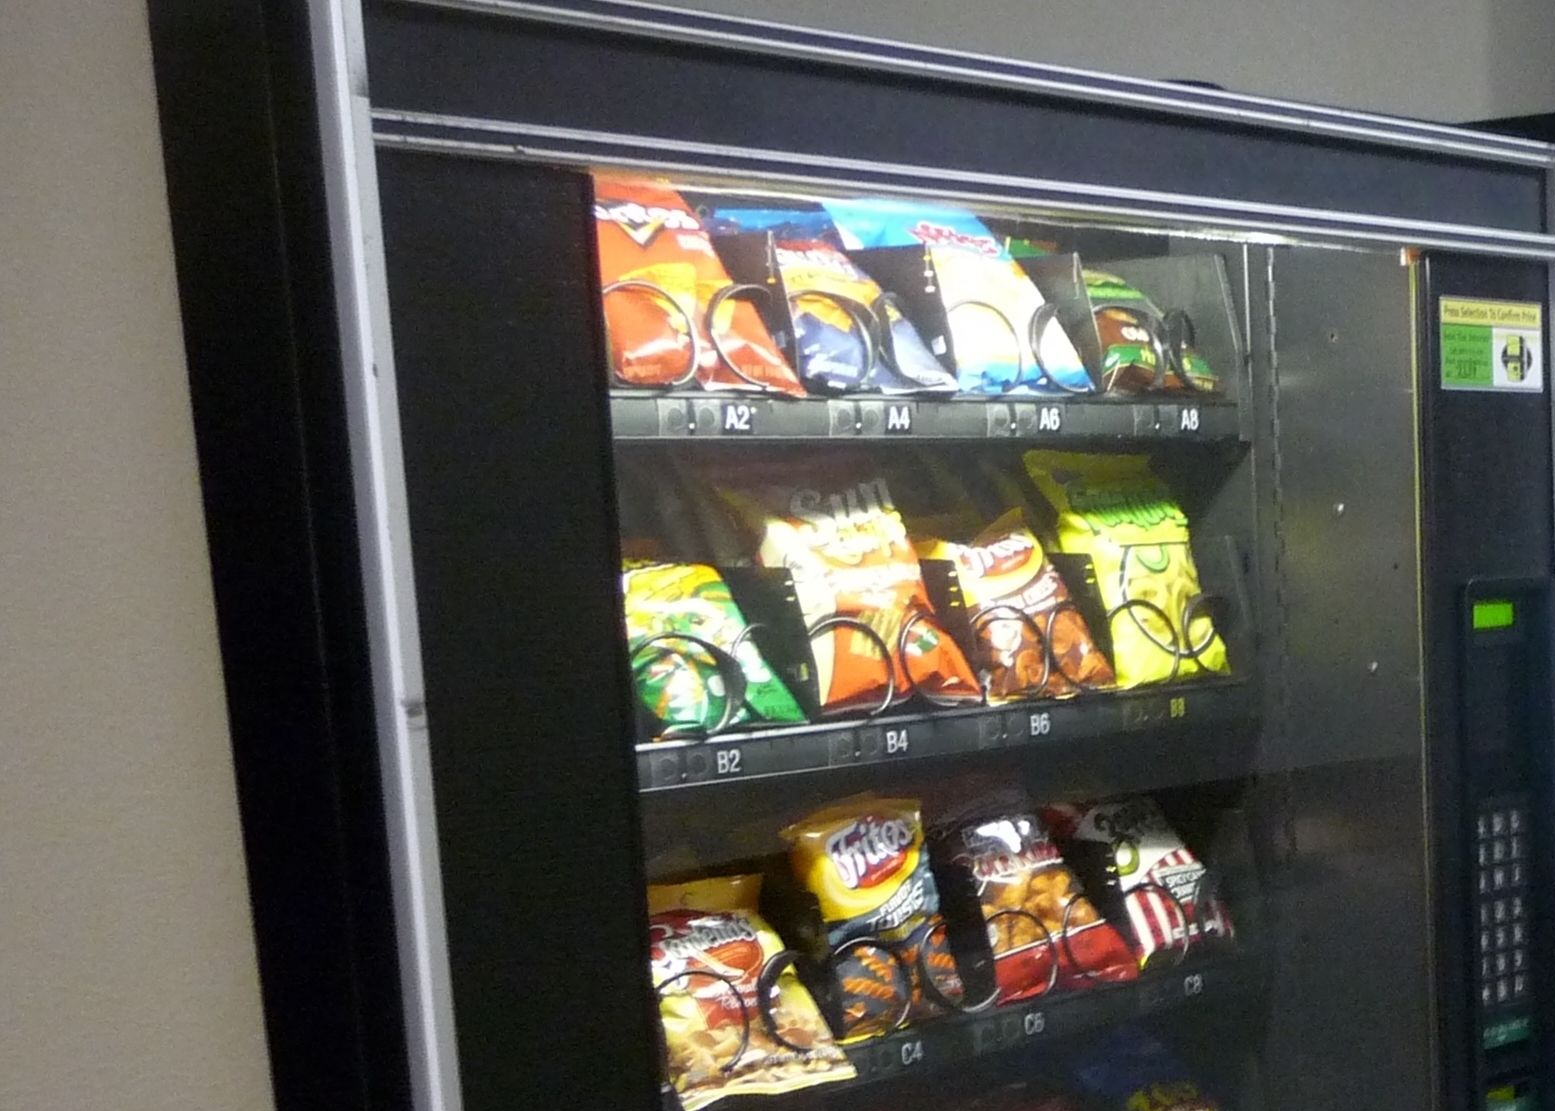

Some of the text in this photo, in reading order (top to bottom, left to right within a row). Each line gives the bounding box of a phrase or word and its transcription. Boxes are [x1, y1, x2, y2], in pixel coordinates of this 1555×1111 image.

[725, 405, 751, 430] A2
[888, 406, 911, 430] A4
[1039, 407, 1060, 431] A6
[1181, 408, 1200, 431] A8
[1030, 713, 1050, 736] B6
[886, 729, 910, 754] B4
[716, 749, 742, 774] B2
[825, 818, 915, 888] Fritos
[901, 1041, 924, 1066] C4
